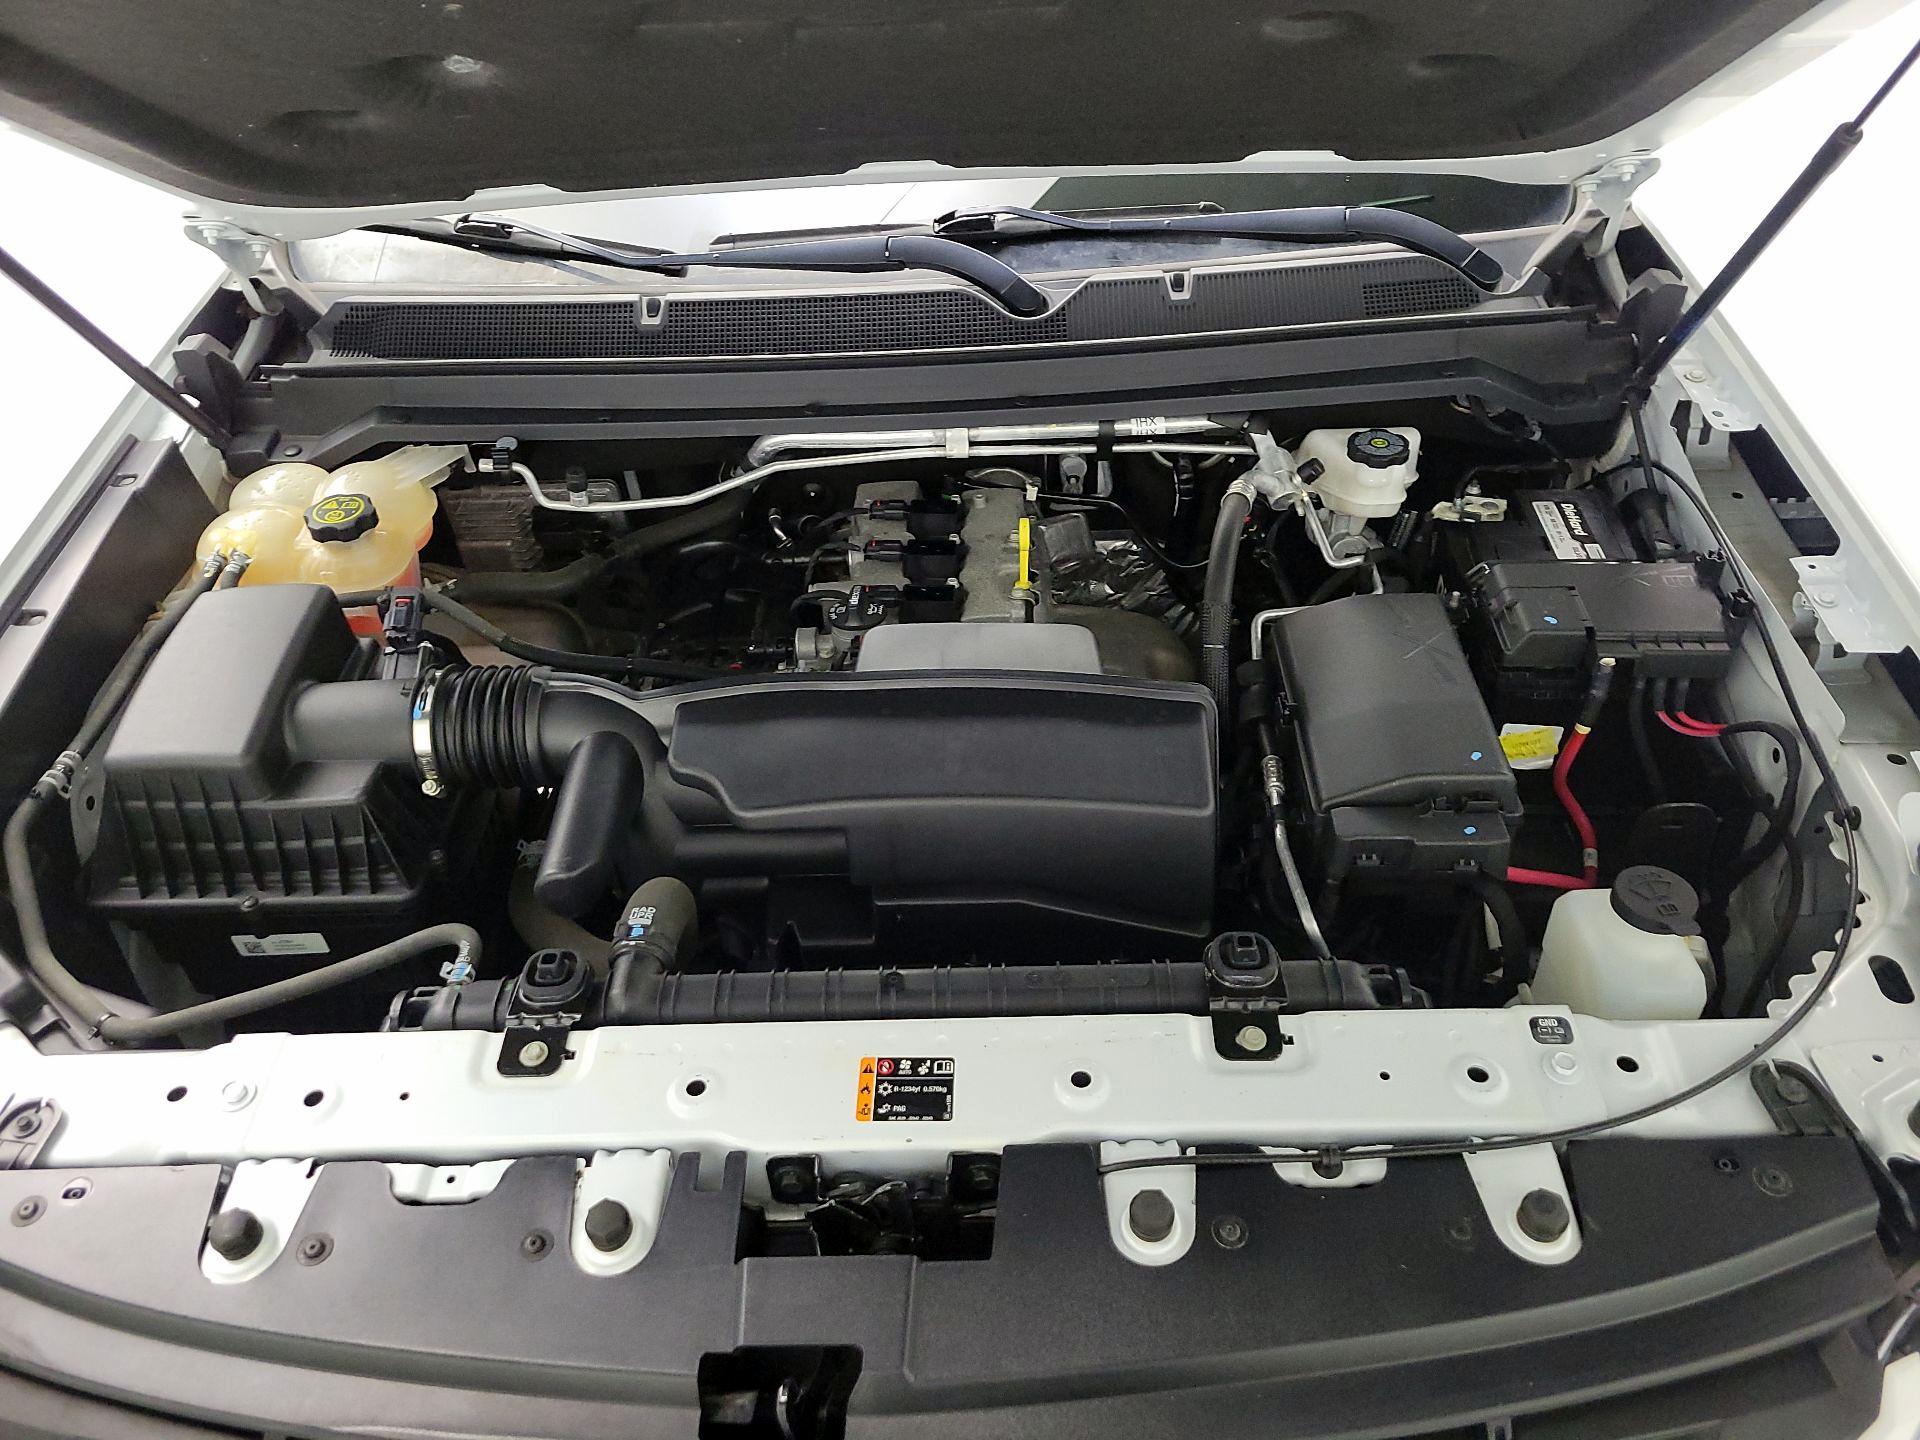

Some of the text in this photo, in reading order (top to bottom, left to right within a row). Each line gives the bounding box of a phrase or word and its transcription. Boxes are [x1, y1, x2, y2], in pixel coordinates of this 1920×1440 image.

[1561, 503, 1589, 536] DieHard
[631, 906, 657, 914] RAD
[1538, 1018, 1558, 1027] GND
[893, 1085, 921, 1094] R-1234yf
